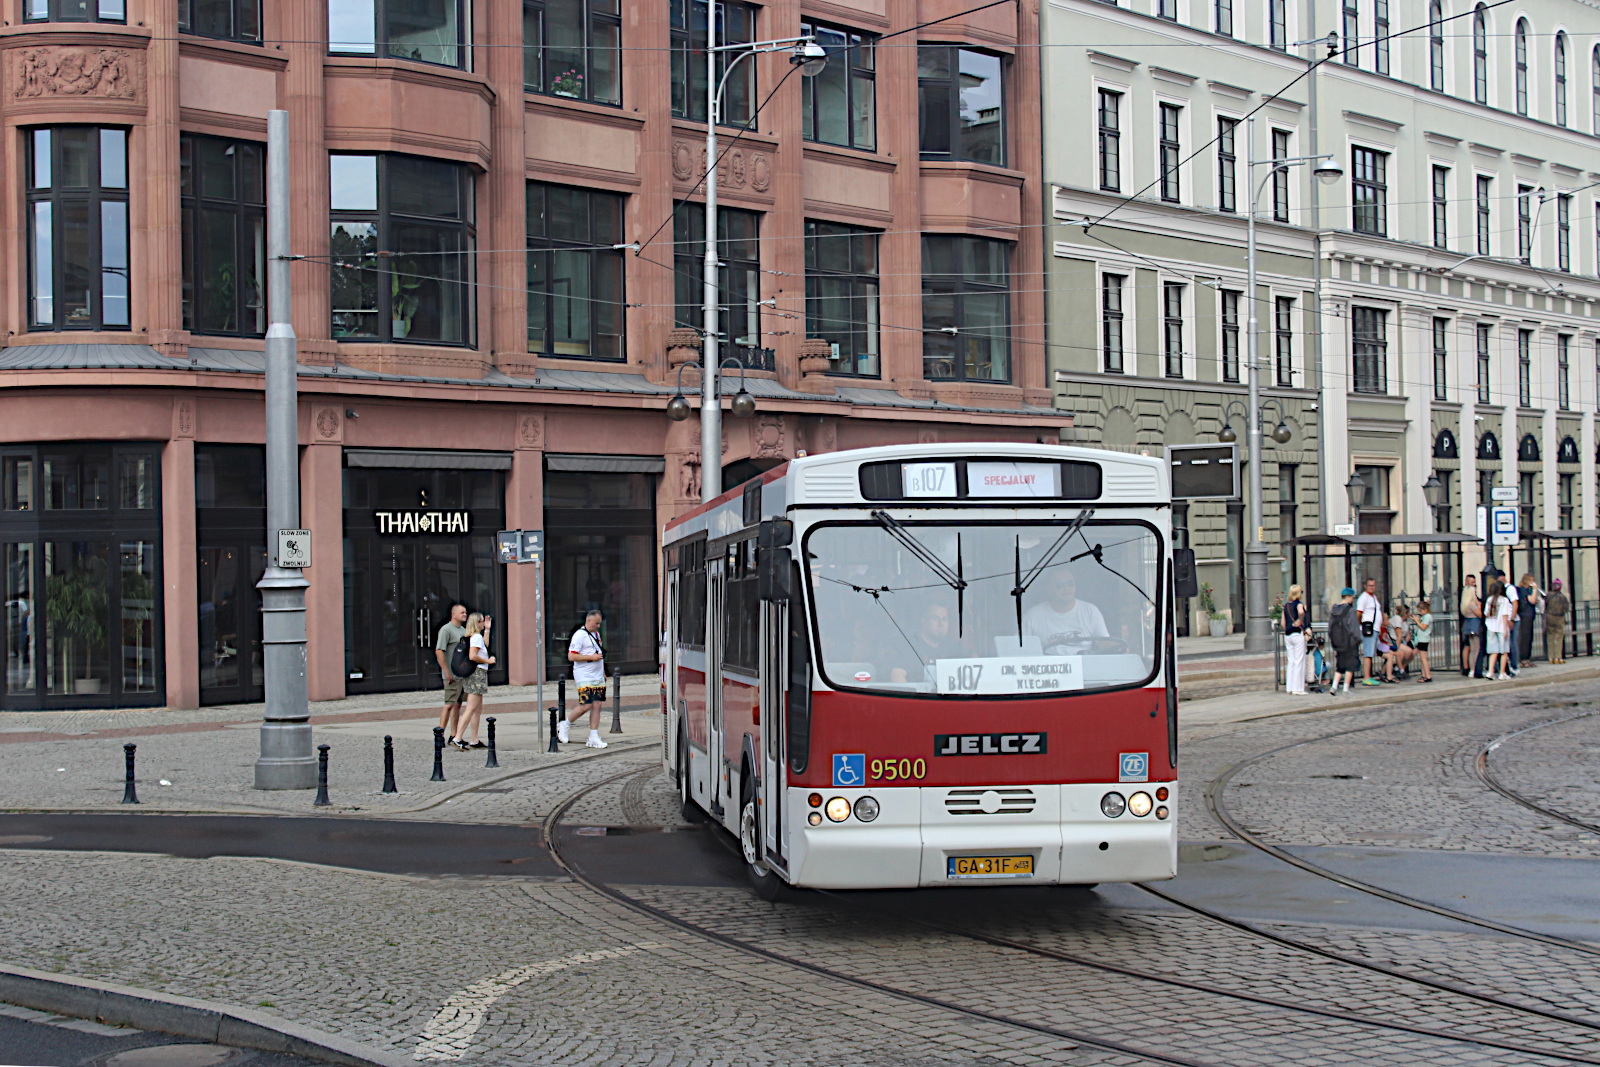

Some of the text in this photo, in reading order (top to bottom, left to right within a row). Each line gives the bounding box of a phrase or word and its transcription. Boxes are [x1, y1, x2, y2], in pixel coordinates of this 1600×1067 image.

[983, 474, 1036, 486] SPECJALNY
[375, 512, 469, 534] THAI THAI
[940, 734, 1041, 755] JELCZ
[870, 758, 927, 781] 9500
[958, 858, 1011, 874] GA 31F
